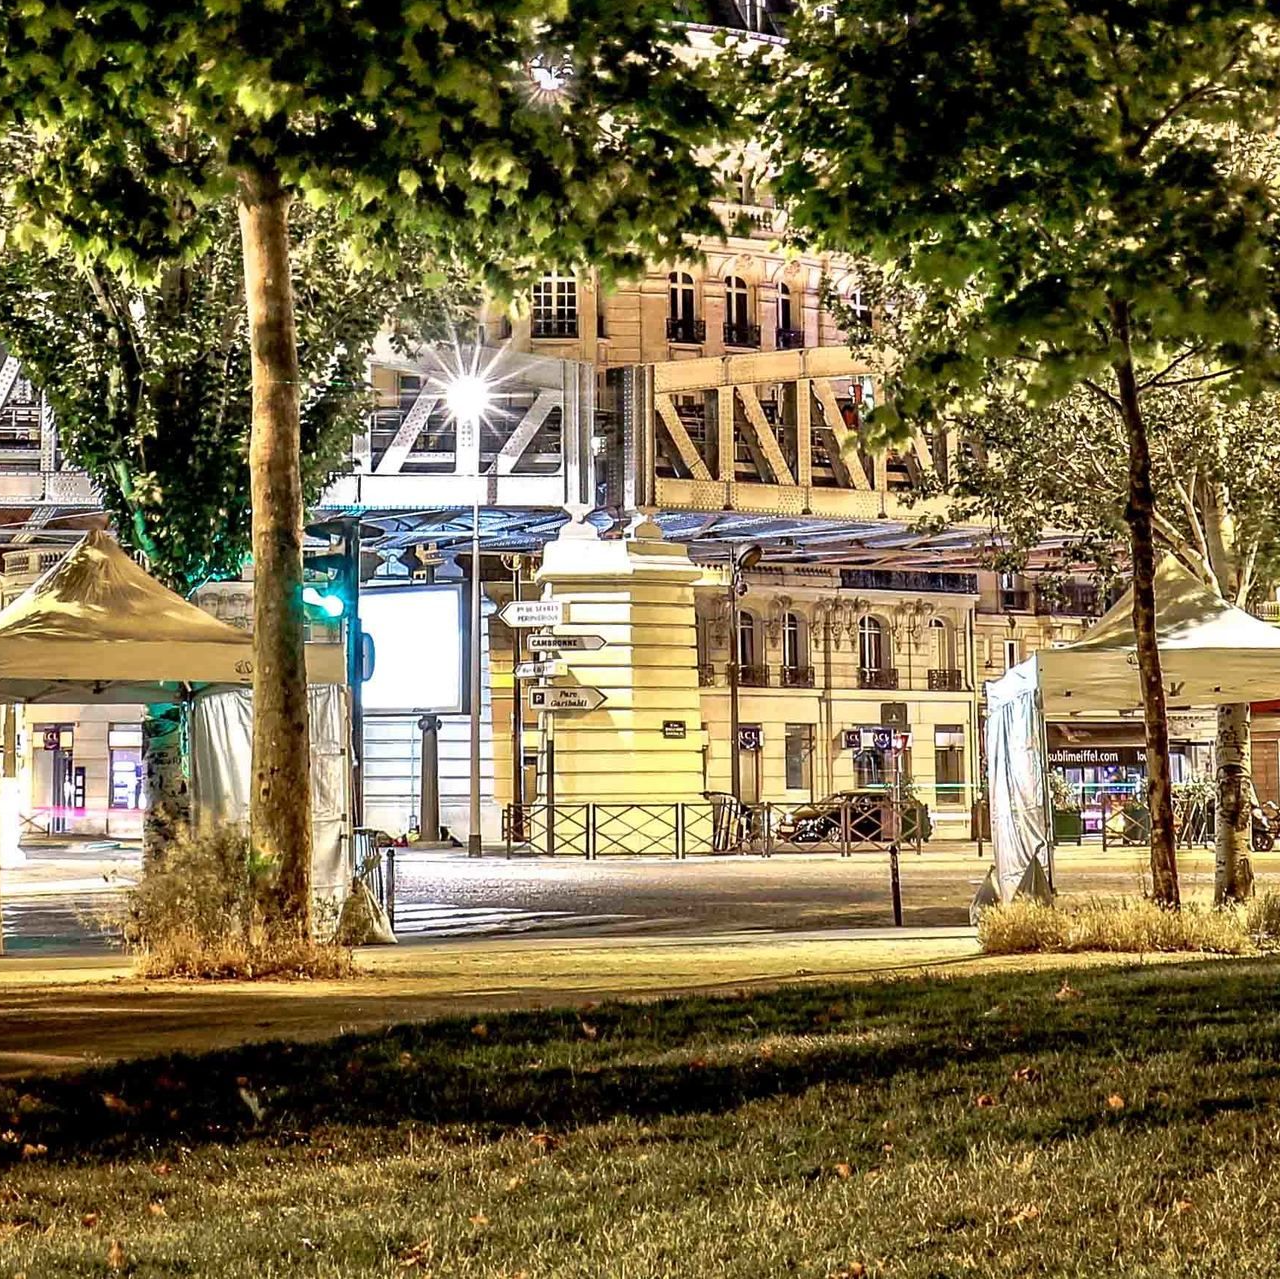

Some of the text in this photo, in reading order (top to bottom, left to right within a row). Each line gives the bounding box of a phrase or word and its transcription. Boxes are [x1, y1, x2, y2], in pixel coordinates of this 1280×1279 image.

[531, 639, 578, 647] CAMBRONNE
[550, 698, 587, 707] Garibaldi
[1048, 749, 1119, 763] sublimeiffel.com
